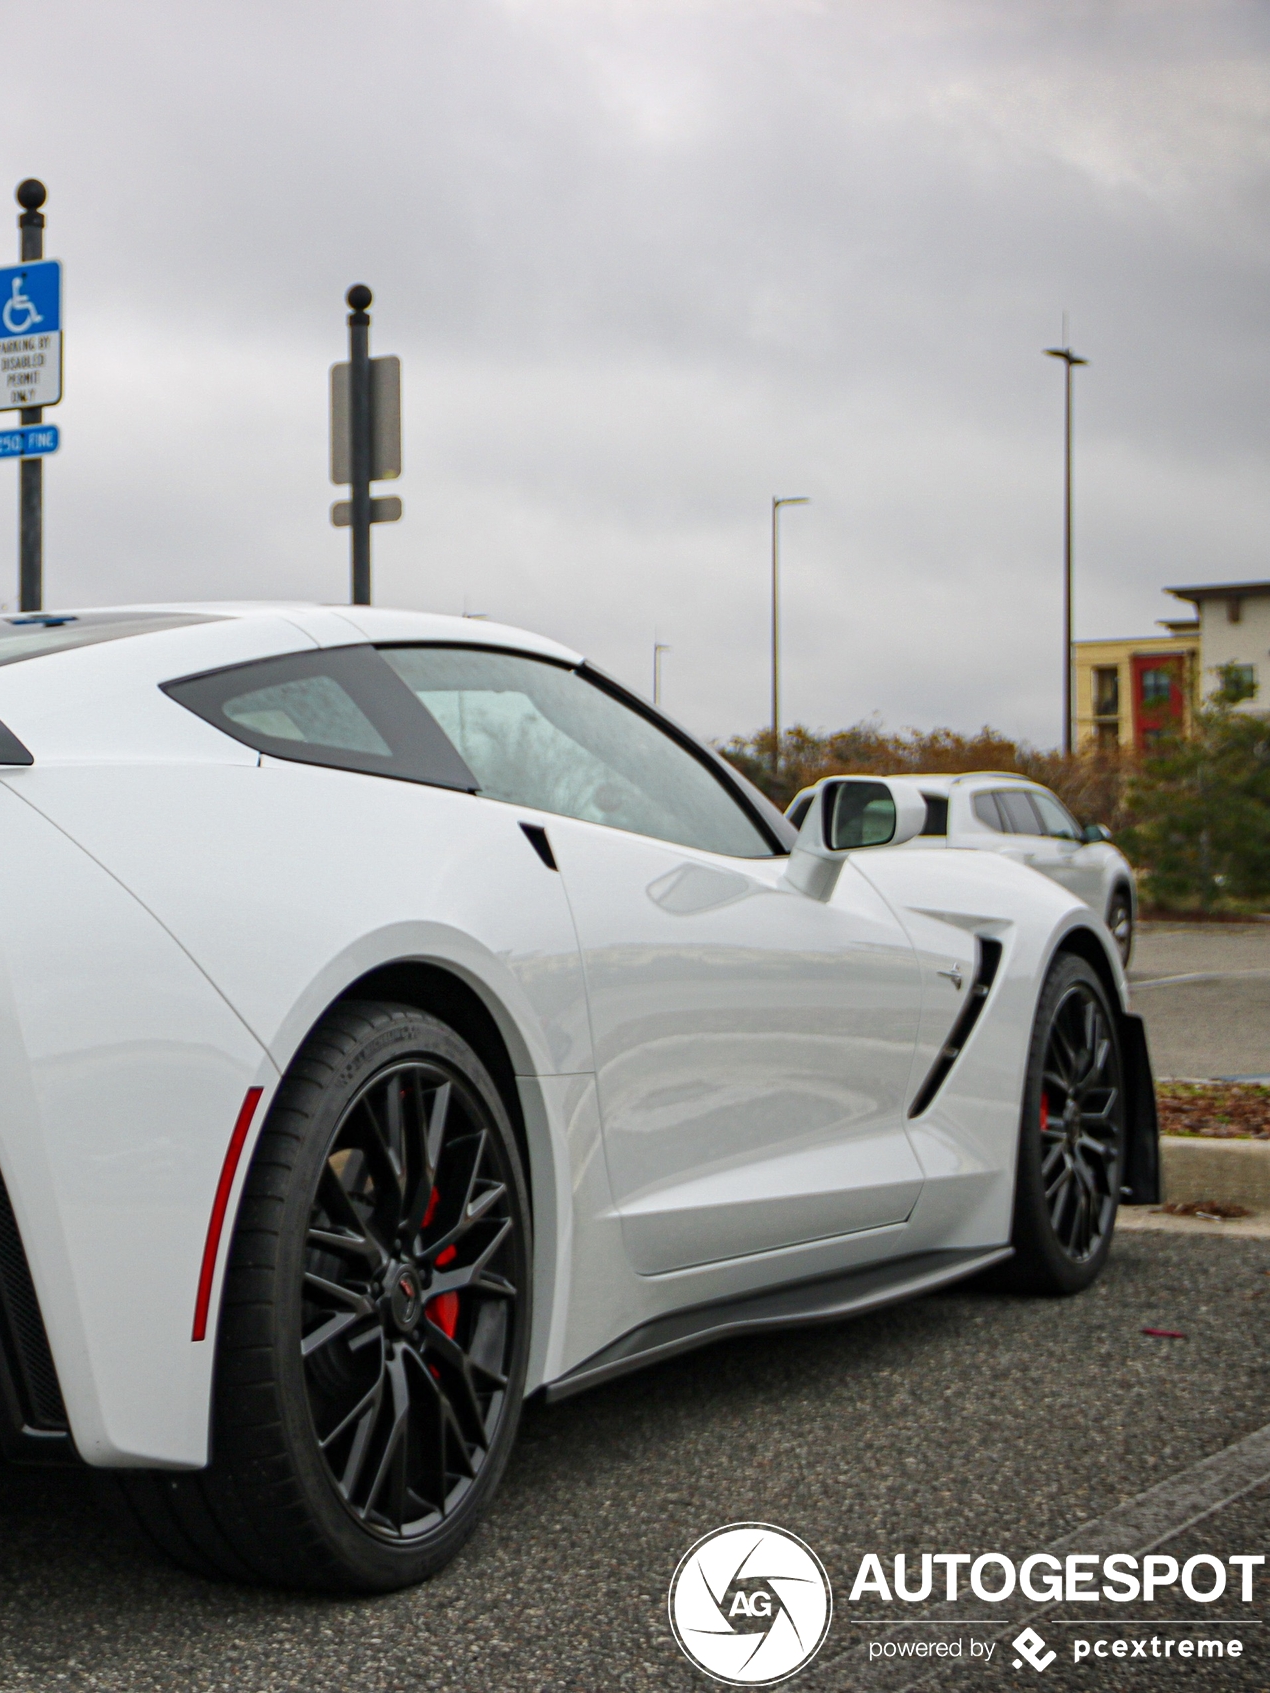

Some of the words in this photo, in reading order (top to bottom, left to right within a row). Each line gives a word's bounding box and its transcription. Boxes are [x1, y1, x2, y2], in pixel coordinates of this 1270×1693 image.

[38, 336, 50, 350] BY
[1, 354, 45, 371] DISABLED
[7, 371, 40, 387] PERMIT
[11, 389, 35, 403] ONLY
[28, 431, 54, 449] FINE
